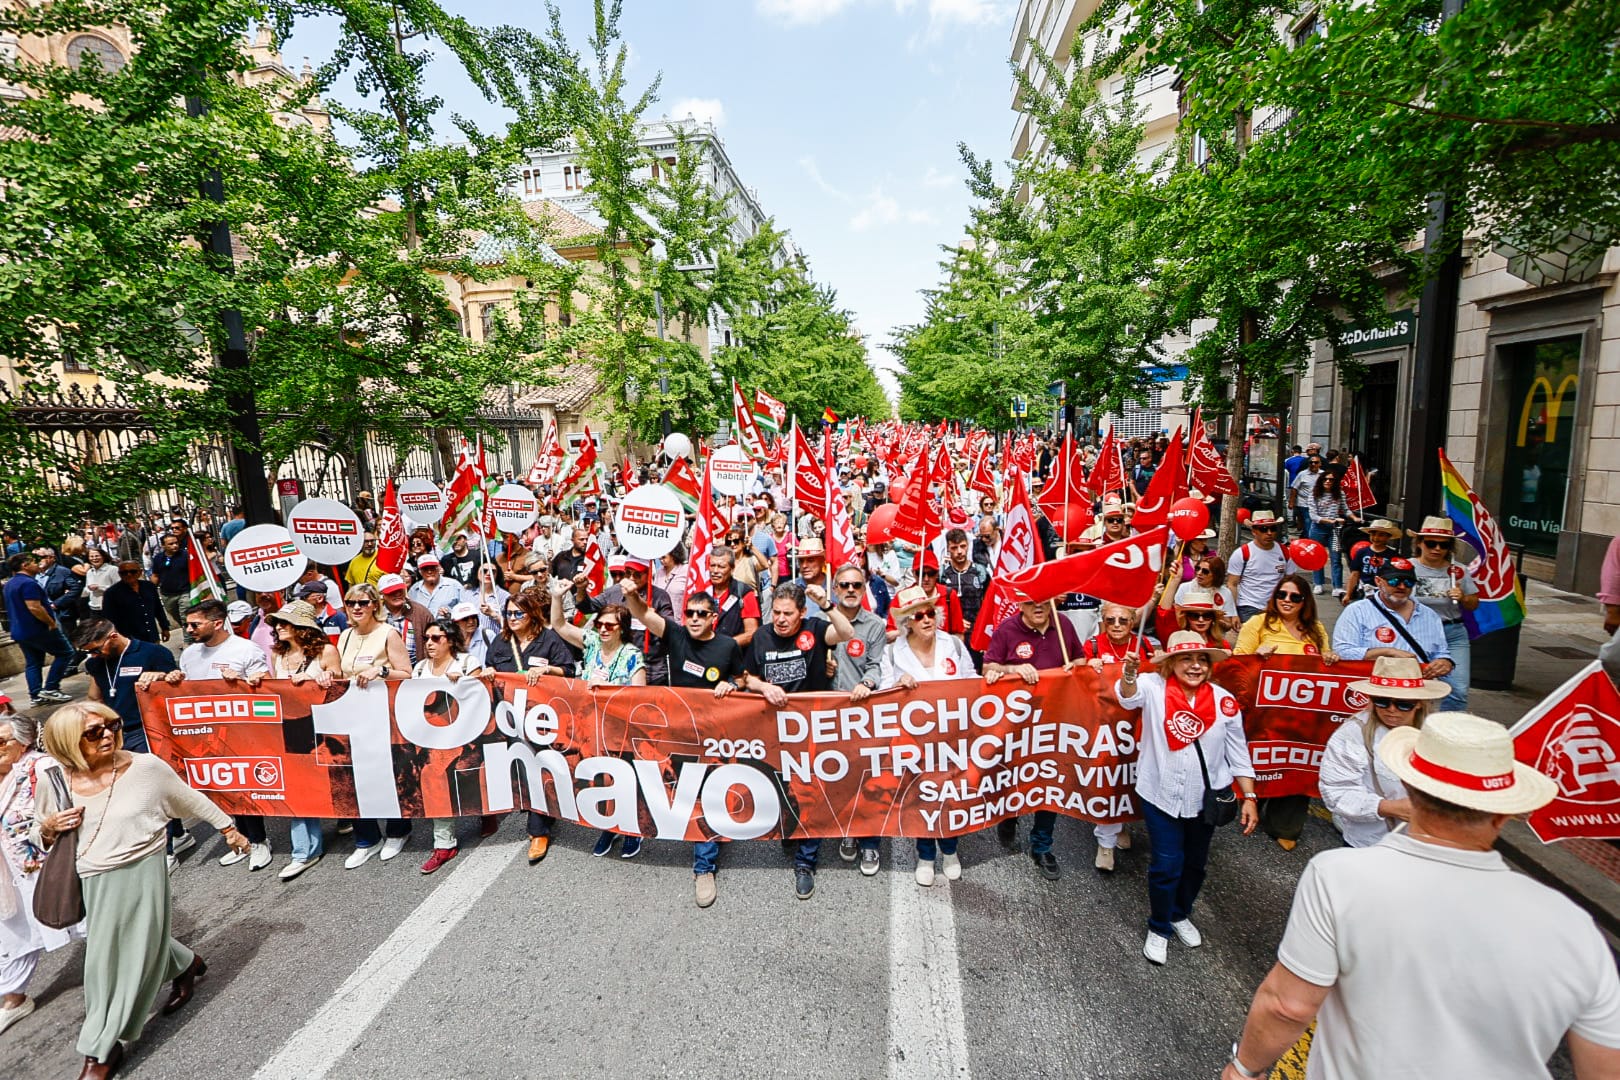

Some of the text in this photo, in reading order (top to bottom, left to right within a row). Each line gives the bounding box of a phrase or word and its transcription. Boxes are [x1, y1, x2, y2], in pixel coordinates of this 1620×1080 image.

[716, 471, 748, 480] hábitat
[407, 502, 438, 511] hábitat
[495, 510, 528, 519] hábitat
[624, 508, 662, 521] CCOO
[295, 521, 337, 532] CCOO
[626, 523, 670, 539] hábitat
[1509, 515, 1560, 534] Gran Vía
[303, 534, 351, 545] hábitat
[233, 547, 279, 563] CCOO
[243, 557, 295, 575] hábitat
[1263, 676, 1340, 706] UGT
[173, 700, 250, 720] CCOO
[495, 688, 559, 746] de
[776, 689, 1042, 744] DERECHOS,
[172, 726, 213, 736] Granada
[703, 738, 767, 760] 2026
[190, 762, 250, 786] UGT
[780, 749, 850, 783] NO
[918, 759, 1066, 802] SALARIOS,
[1255, 771, 1284, 782] anada
[1482, 777, 1505, 789] UGT
[251, 792, 286, 800] Granada
[919, 785, 1135, 832] Y DEMOCRACIA
